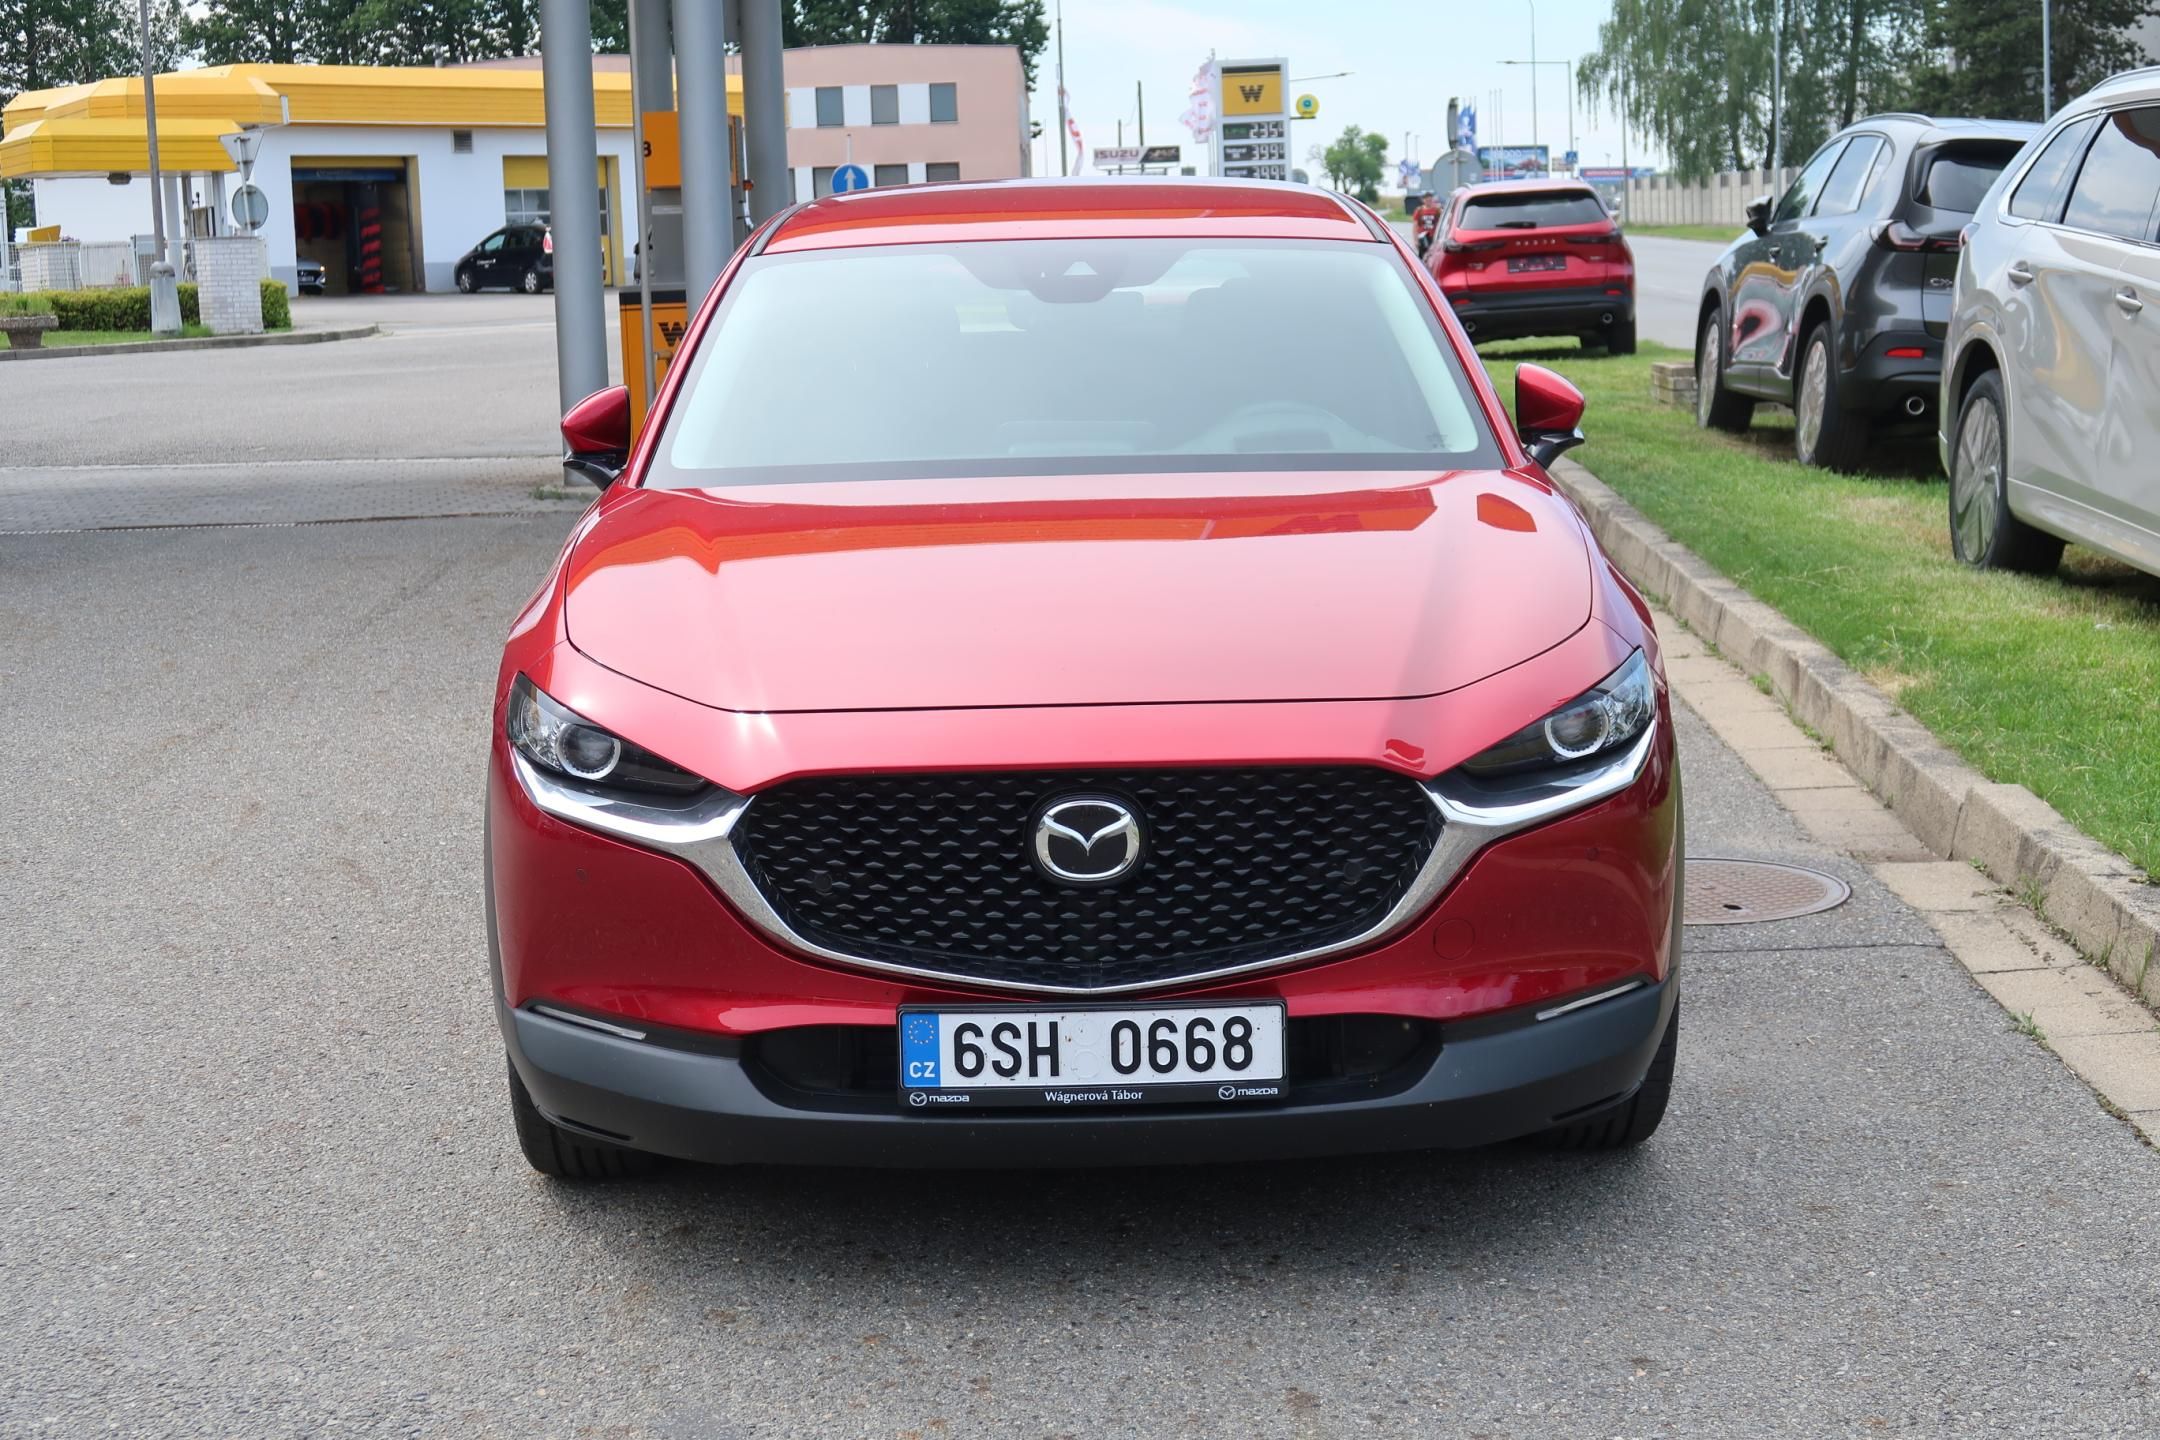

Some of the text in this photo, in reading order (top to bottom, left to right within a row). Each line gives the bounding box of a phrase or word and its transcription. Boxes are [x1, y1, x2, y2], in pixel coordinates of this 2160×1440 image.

[1239, 84, 1264, 103] W
[1095, 149, 1139, 160] ISUZU
[953, 1015, 1253, 1078] 6SH 0668
[909, 1061, 936, 1078] CZ
[1044, 1089, 1143, 1104] Wágnerová Tábor
